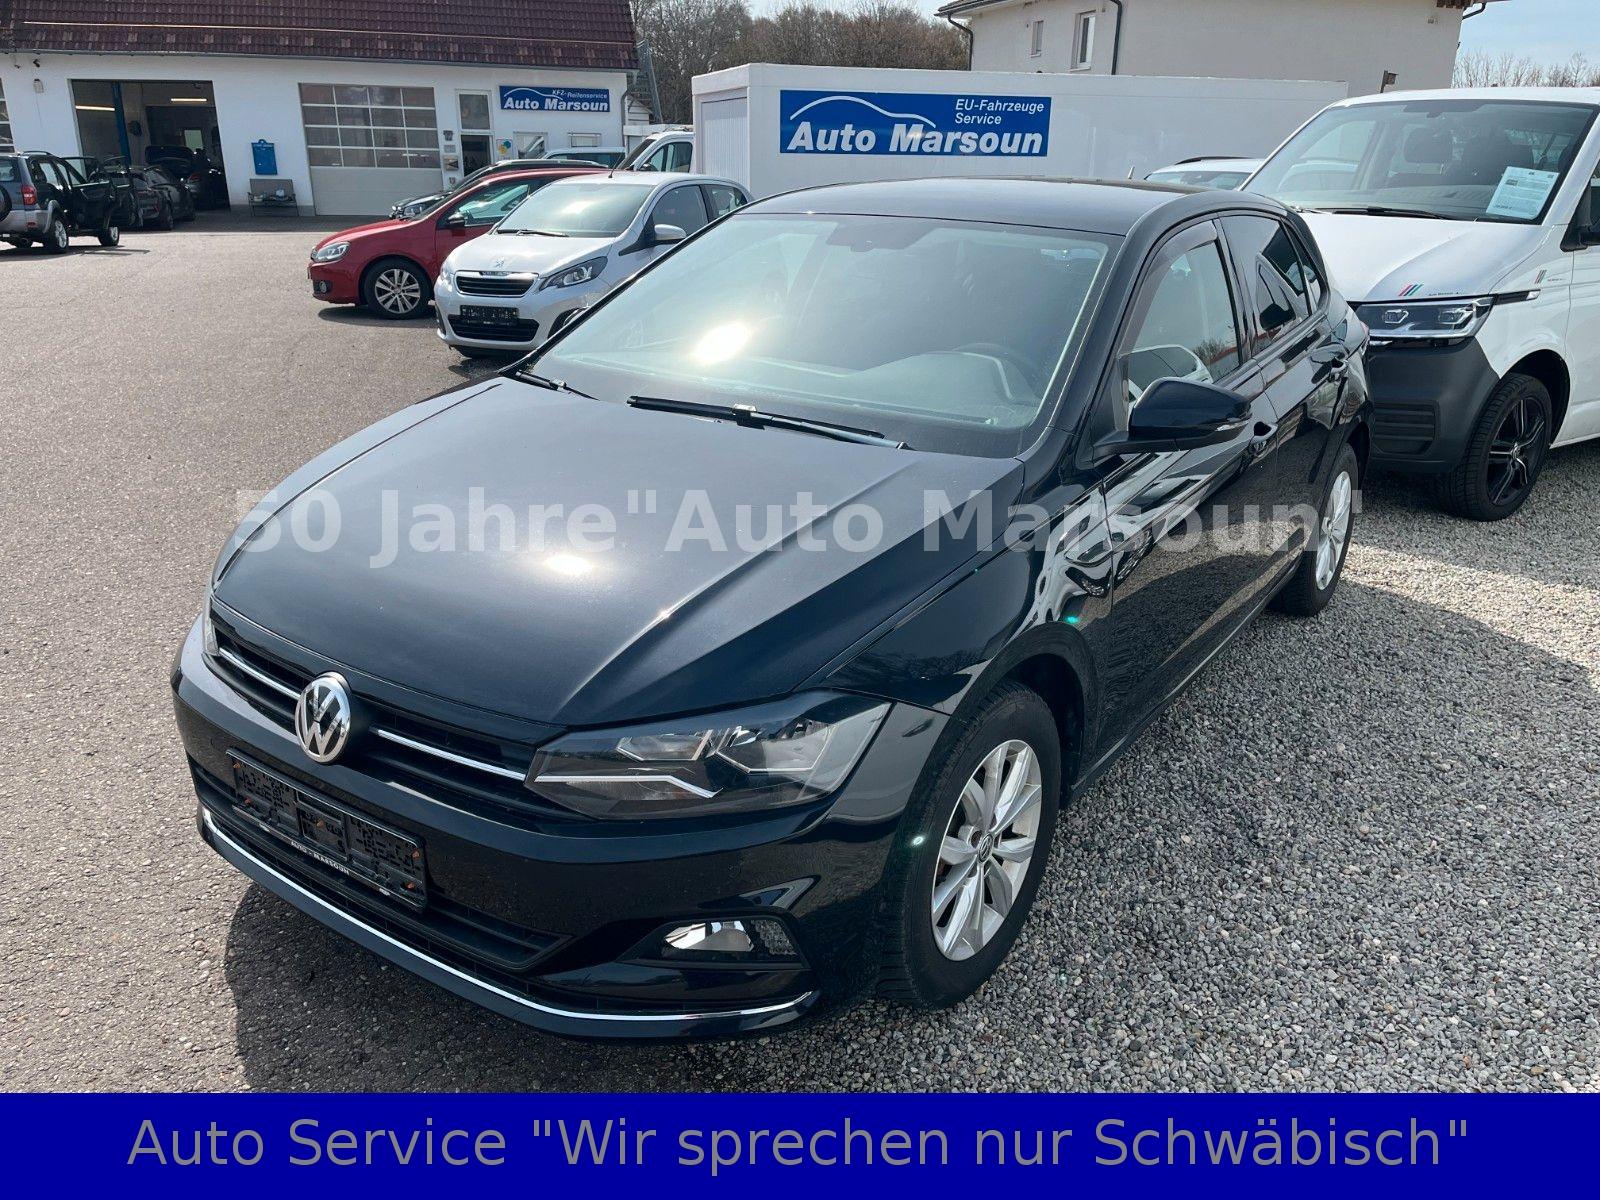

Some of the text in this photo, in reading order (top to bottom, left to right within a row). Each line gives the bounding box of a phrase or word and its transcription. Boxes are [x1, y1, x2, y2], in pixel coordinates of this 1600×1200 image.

[503, 97, 608, 111] Auto Marsoun
[955, 98, 1044, 114] EU-Fahrzeuge
[955, 112, 1002, 125] Service
[787, 121, 1043, 155] Auto Marsoun
